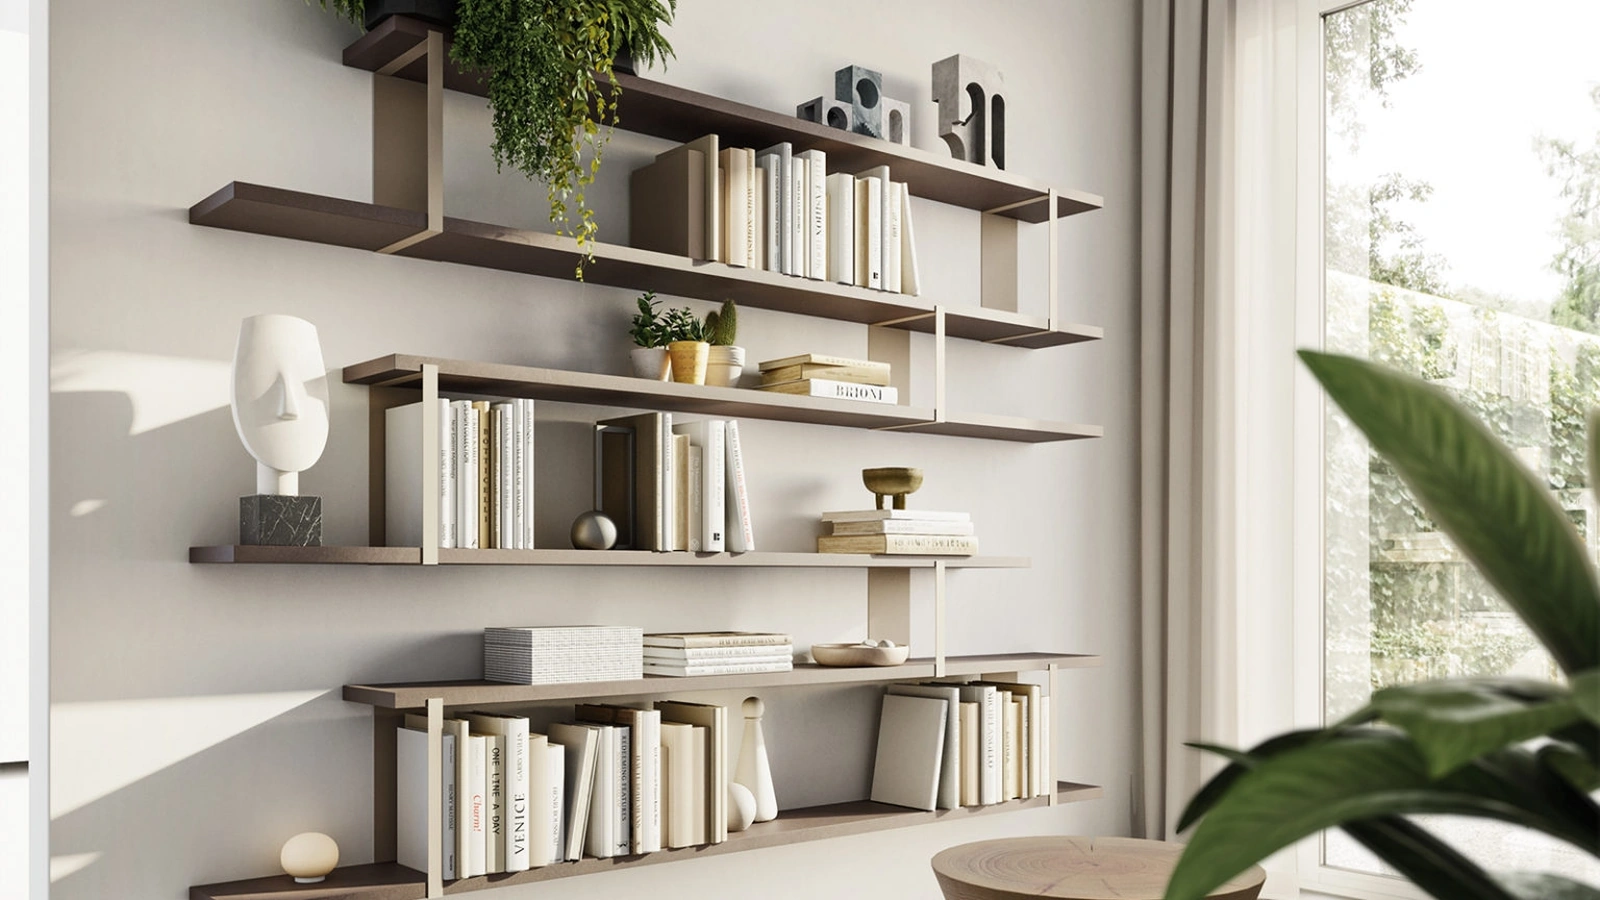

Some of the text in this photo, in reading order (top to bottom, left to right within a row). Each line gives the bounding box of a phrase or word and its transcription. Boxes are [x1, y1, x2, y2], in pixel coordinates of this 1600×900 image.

[836, 384, 882, 401] BRIONI
[492, 747, 500, 766] ONE
[492, 772, 500, 797] LINE
[473, 794, 482, 832] Charm!
[514, 793, 525, 855] VENICE
[492, 815, 500, 835] DAY
